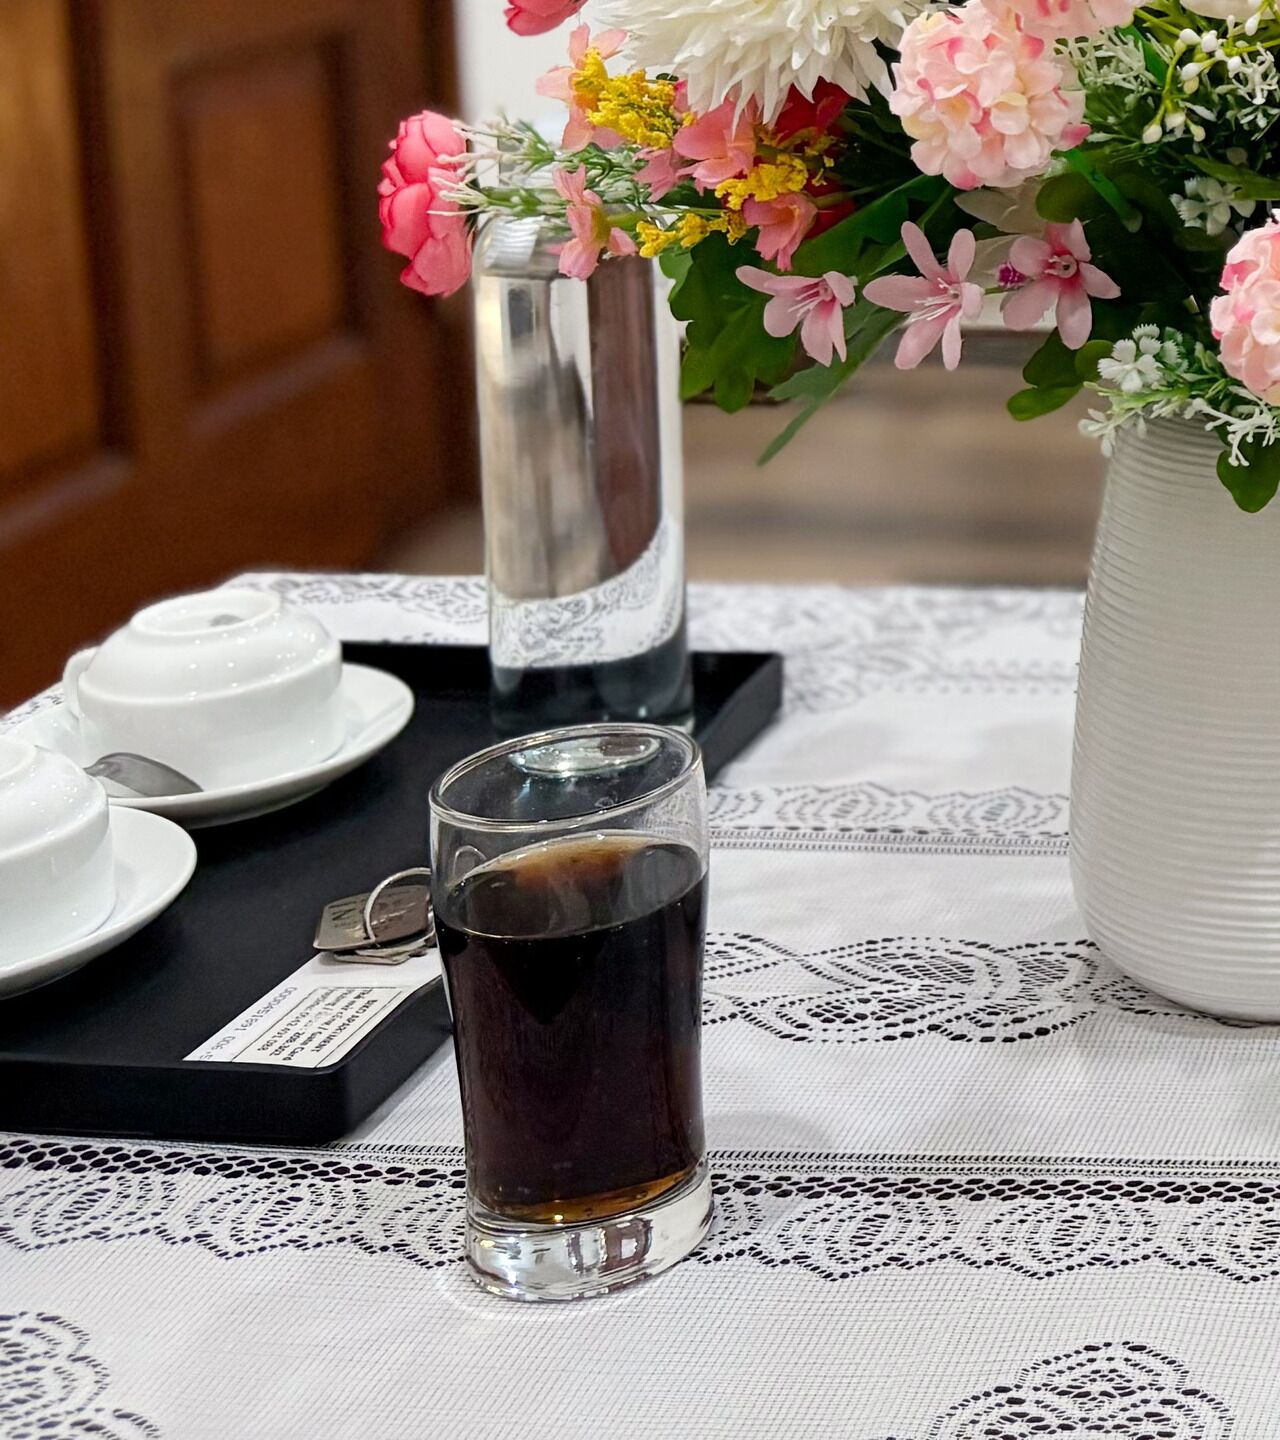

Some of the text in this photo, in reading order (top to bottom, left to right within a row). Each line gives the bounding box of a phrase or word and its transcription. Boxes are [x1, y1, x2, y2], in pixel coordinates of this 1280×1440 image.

[233, 987, 298, 1031] 0000451891
[310, 1014, 361, 1053] APARTMENT
[281, 1046, 306, 1061] Card
